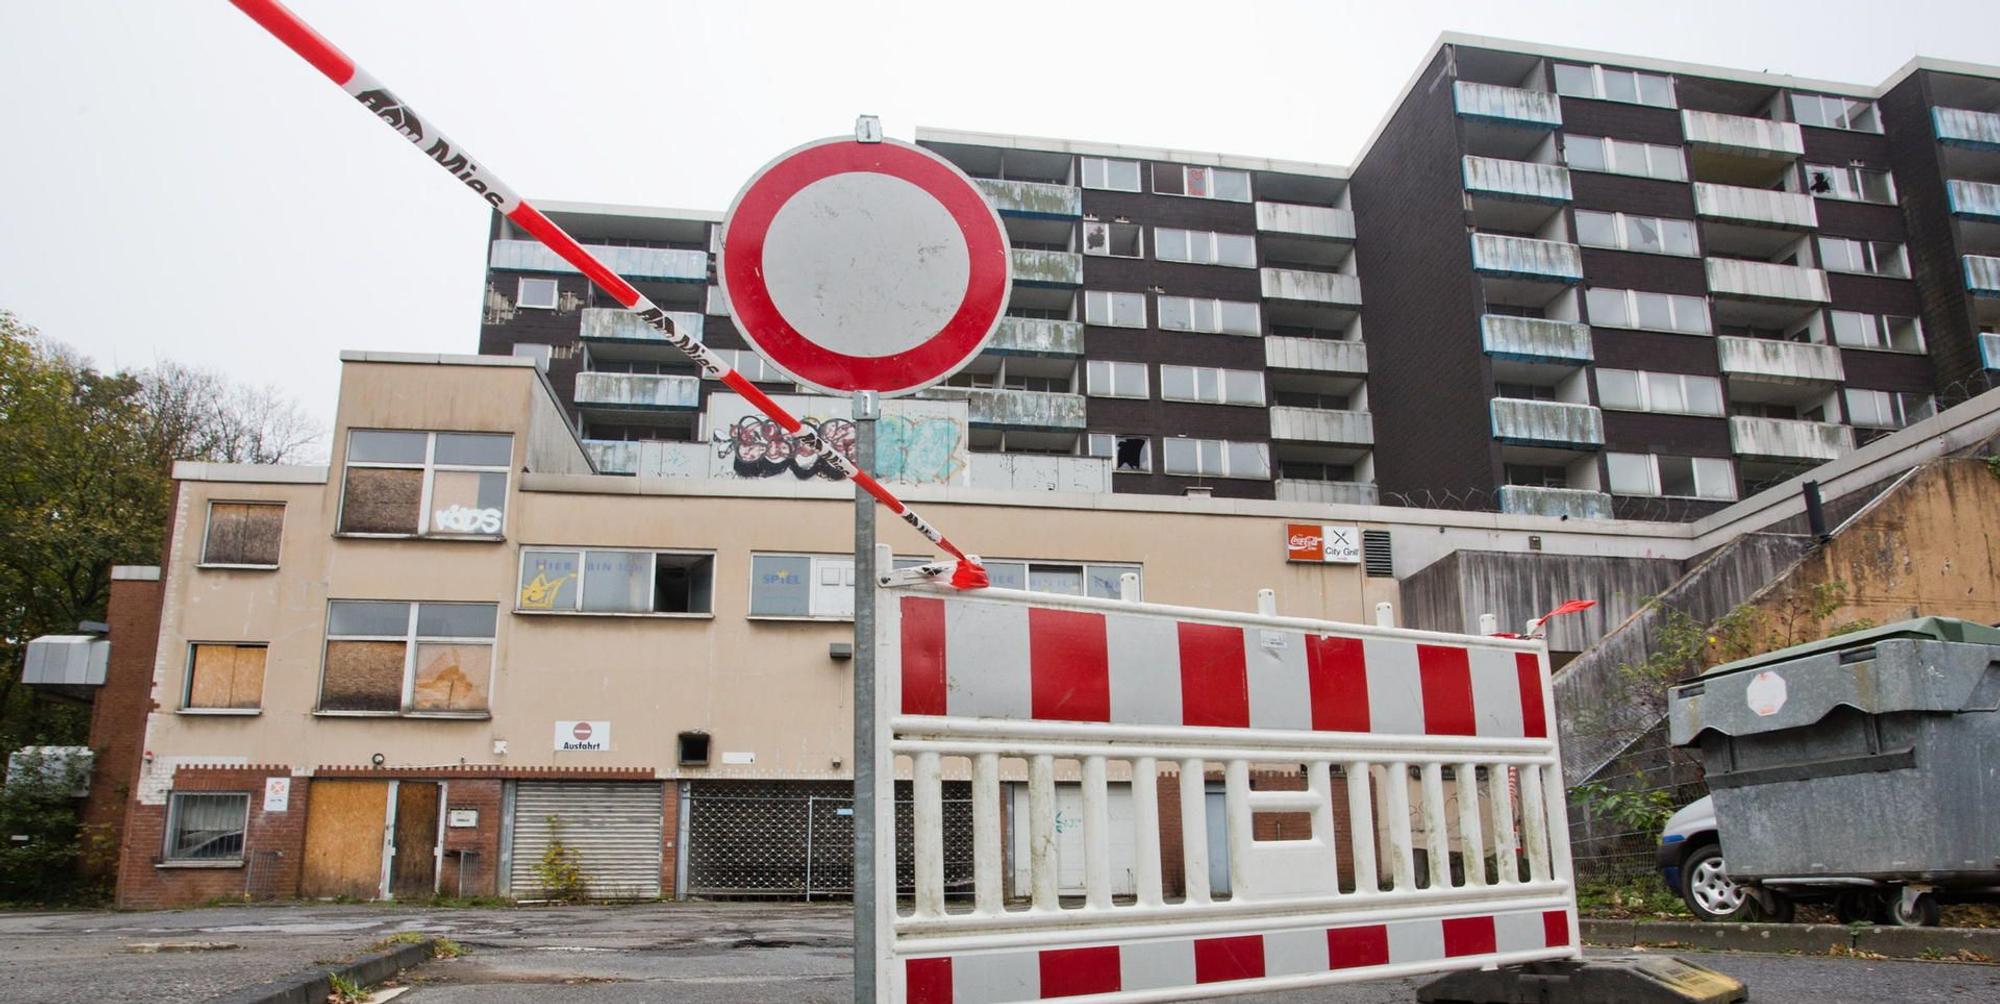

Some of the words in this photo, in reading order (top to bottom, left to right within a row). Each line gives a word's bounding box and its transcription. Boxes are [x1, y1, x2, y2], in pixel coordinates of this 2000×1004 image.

[1325, 547, 1340, 556] City
[1343, 547, 1359, 556] Grill
[761, 575, 801, 585] SPIEL
[563, 741, 600, 750] Ausfahrt
